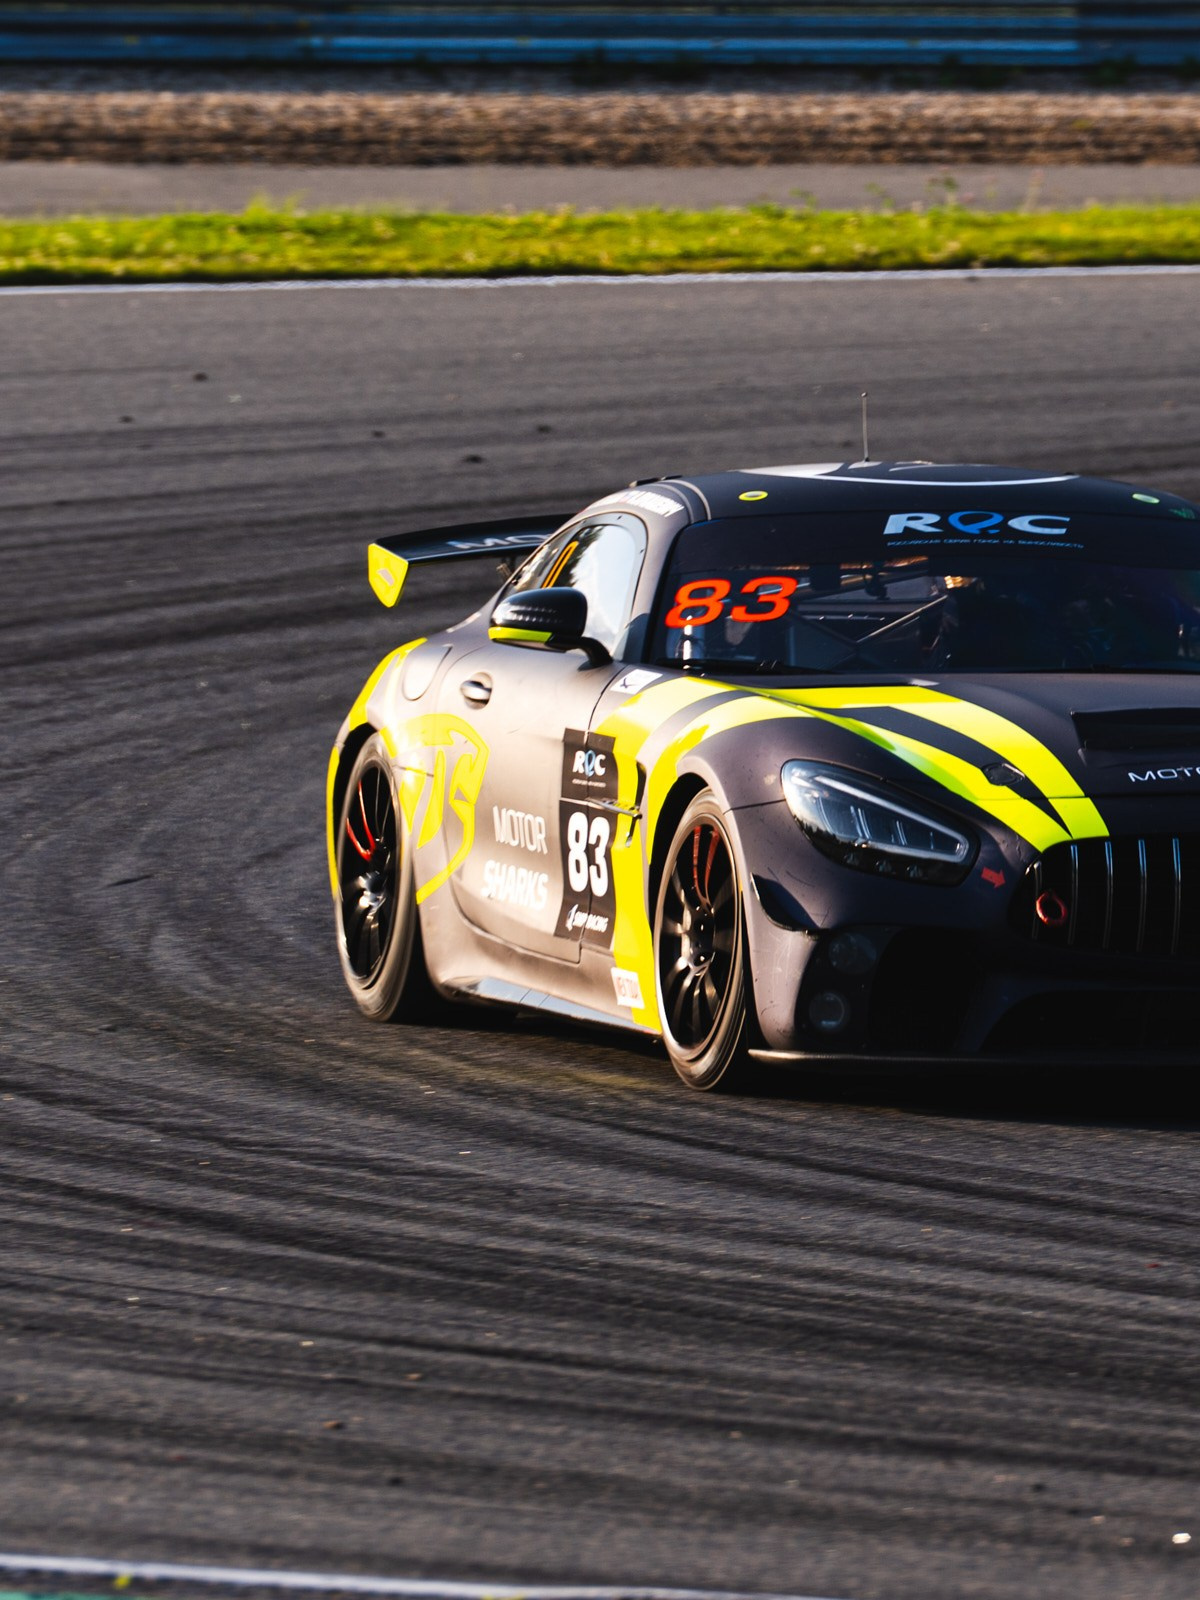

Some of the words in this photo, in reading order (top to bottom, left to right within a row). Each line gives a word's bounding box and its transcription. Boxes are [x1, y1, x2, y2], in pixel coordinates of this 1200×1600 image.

[665, 576, 798, 628] 83
[492, 805, 549, 855] MOTOR
[567, 811, 610, 897] 83
[481, 859, 549, 911] SHARKS
